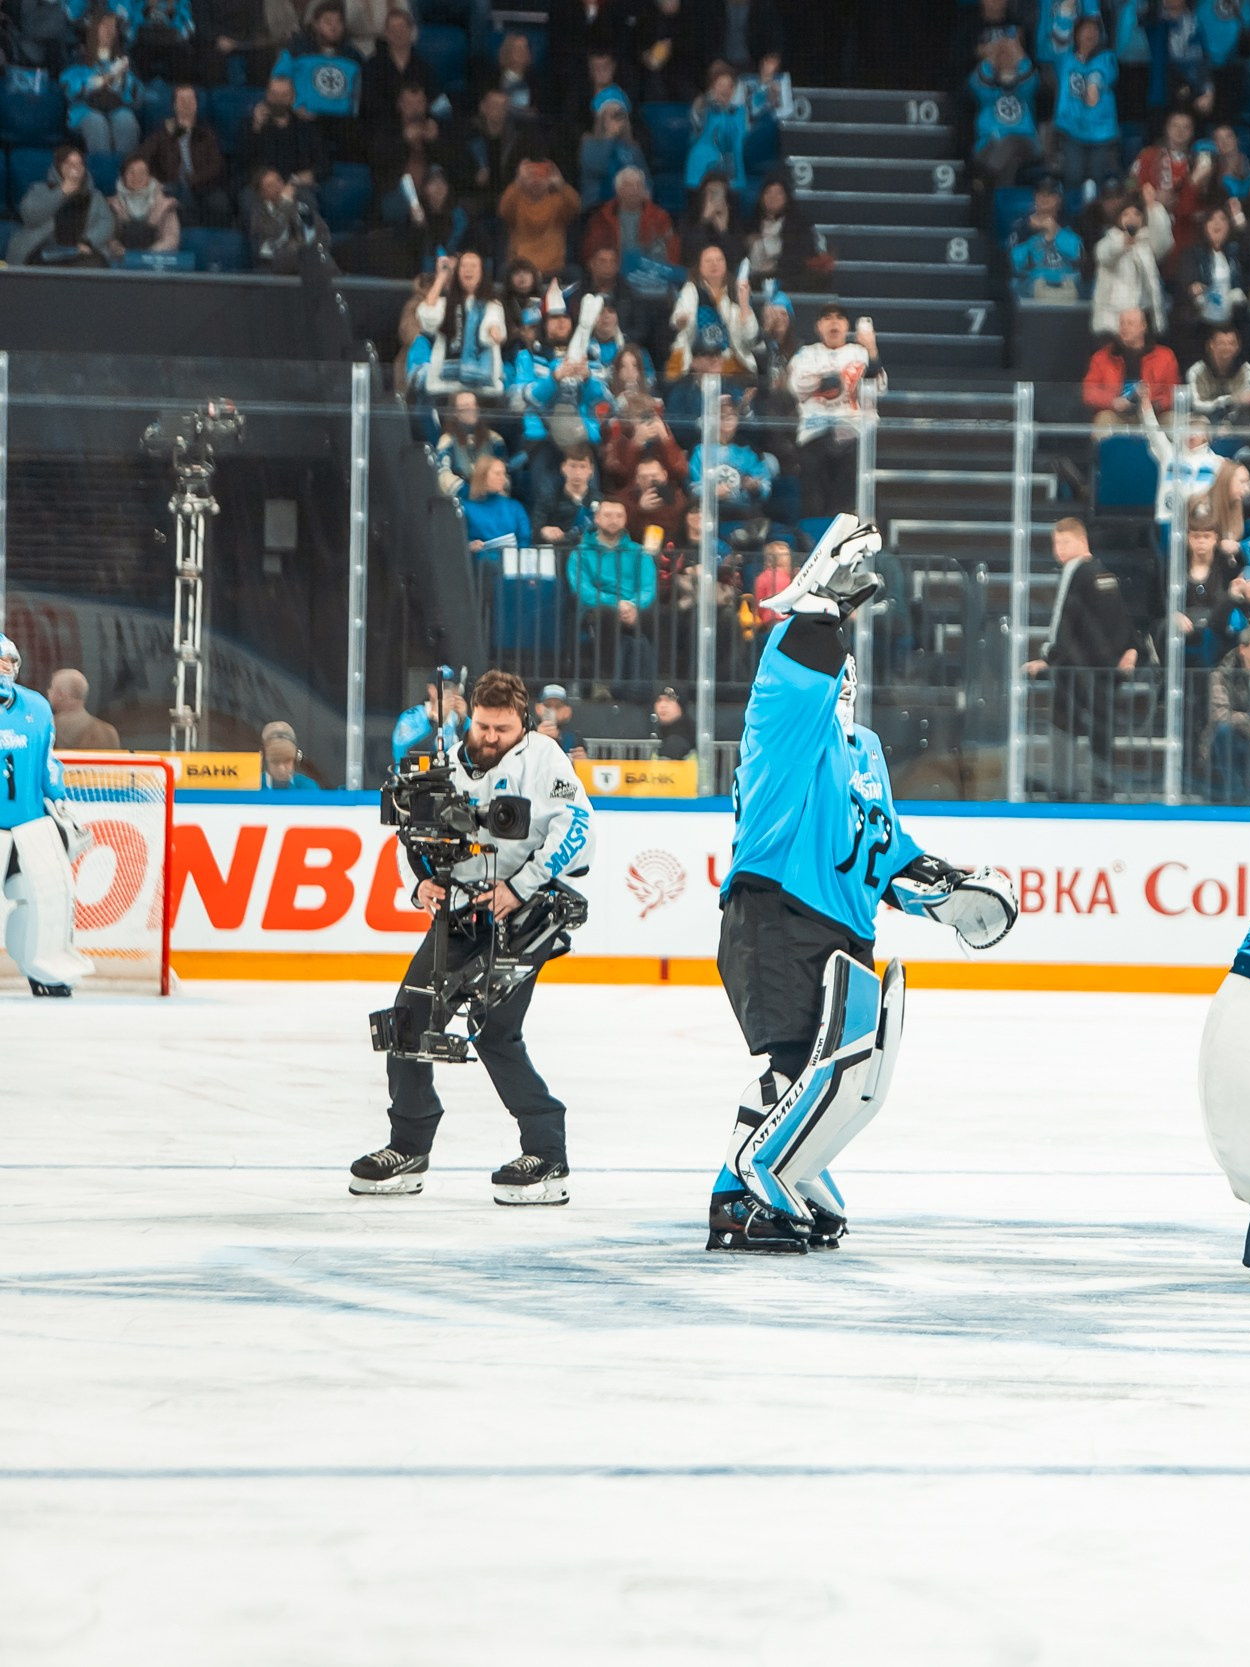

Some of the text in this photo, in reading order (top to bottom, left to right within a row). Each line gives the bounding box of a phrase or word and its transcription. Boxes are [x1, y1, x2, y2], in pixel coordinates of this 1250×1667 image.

[907, 100, 940, 124] 10
[793, 161, 814, 187] 9
[935, 164, 956, 190] 9
[948, 236, 969, 263] 8
[967, 308, 986, 334] 7
[186, 765, 239, 777] БАНК
[624, 773, 675, 784] БАНК
